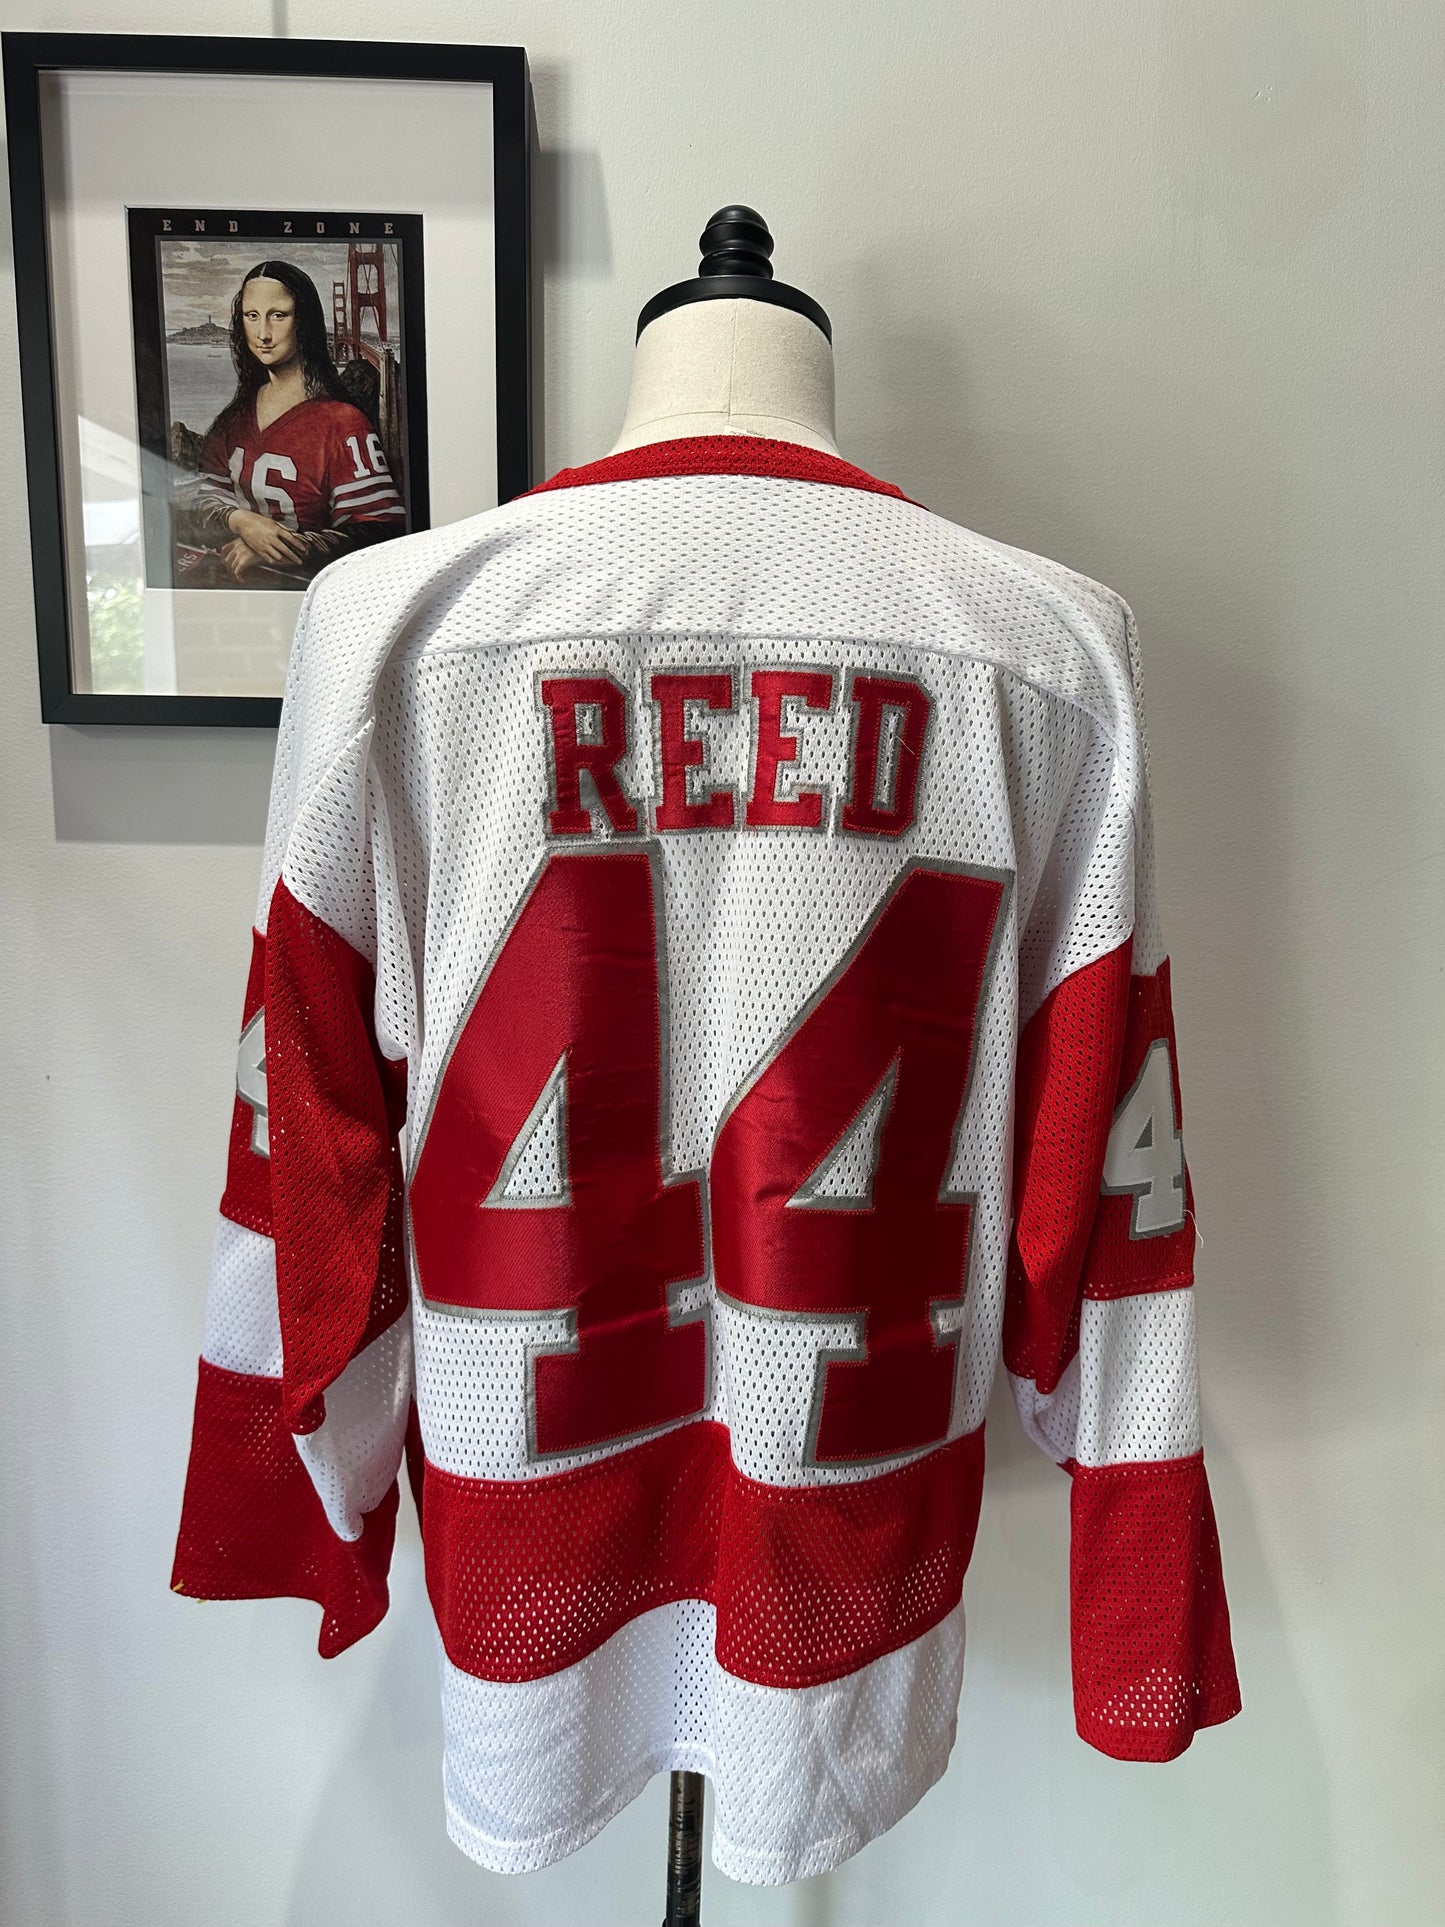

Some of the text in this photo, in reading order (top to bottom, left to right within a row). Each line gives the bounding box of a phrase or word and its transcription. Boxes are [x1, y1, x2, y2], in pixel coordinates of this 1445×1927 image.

[162, 219, 395, 235] END ZONE
[345, 433, 390, 479] 16
[533, 661, 938, 843] REED
[406, 840, 1016, 1469] 44
